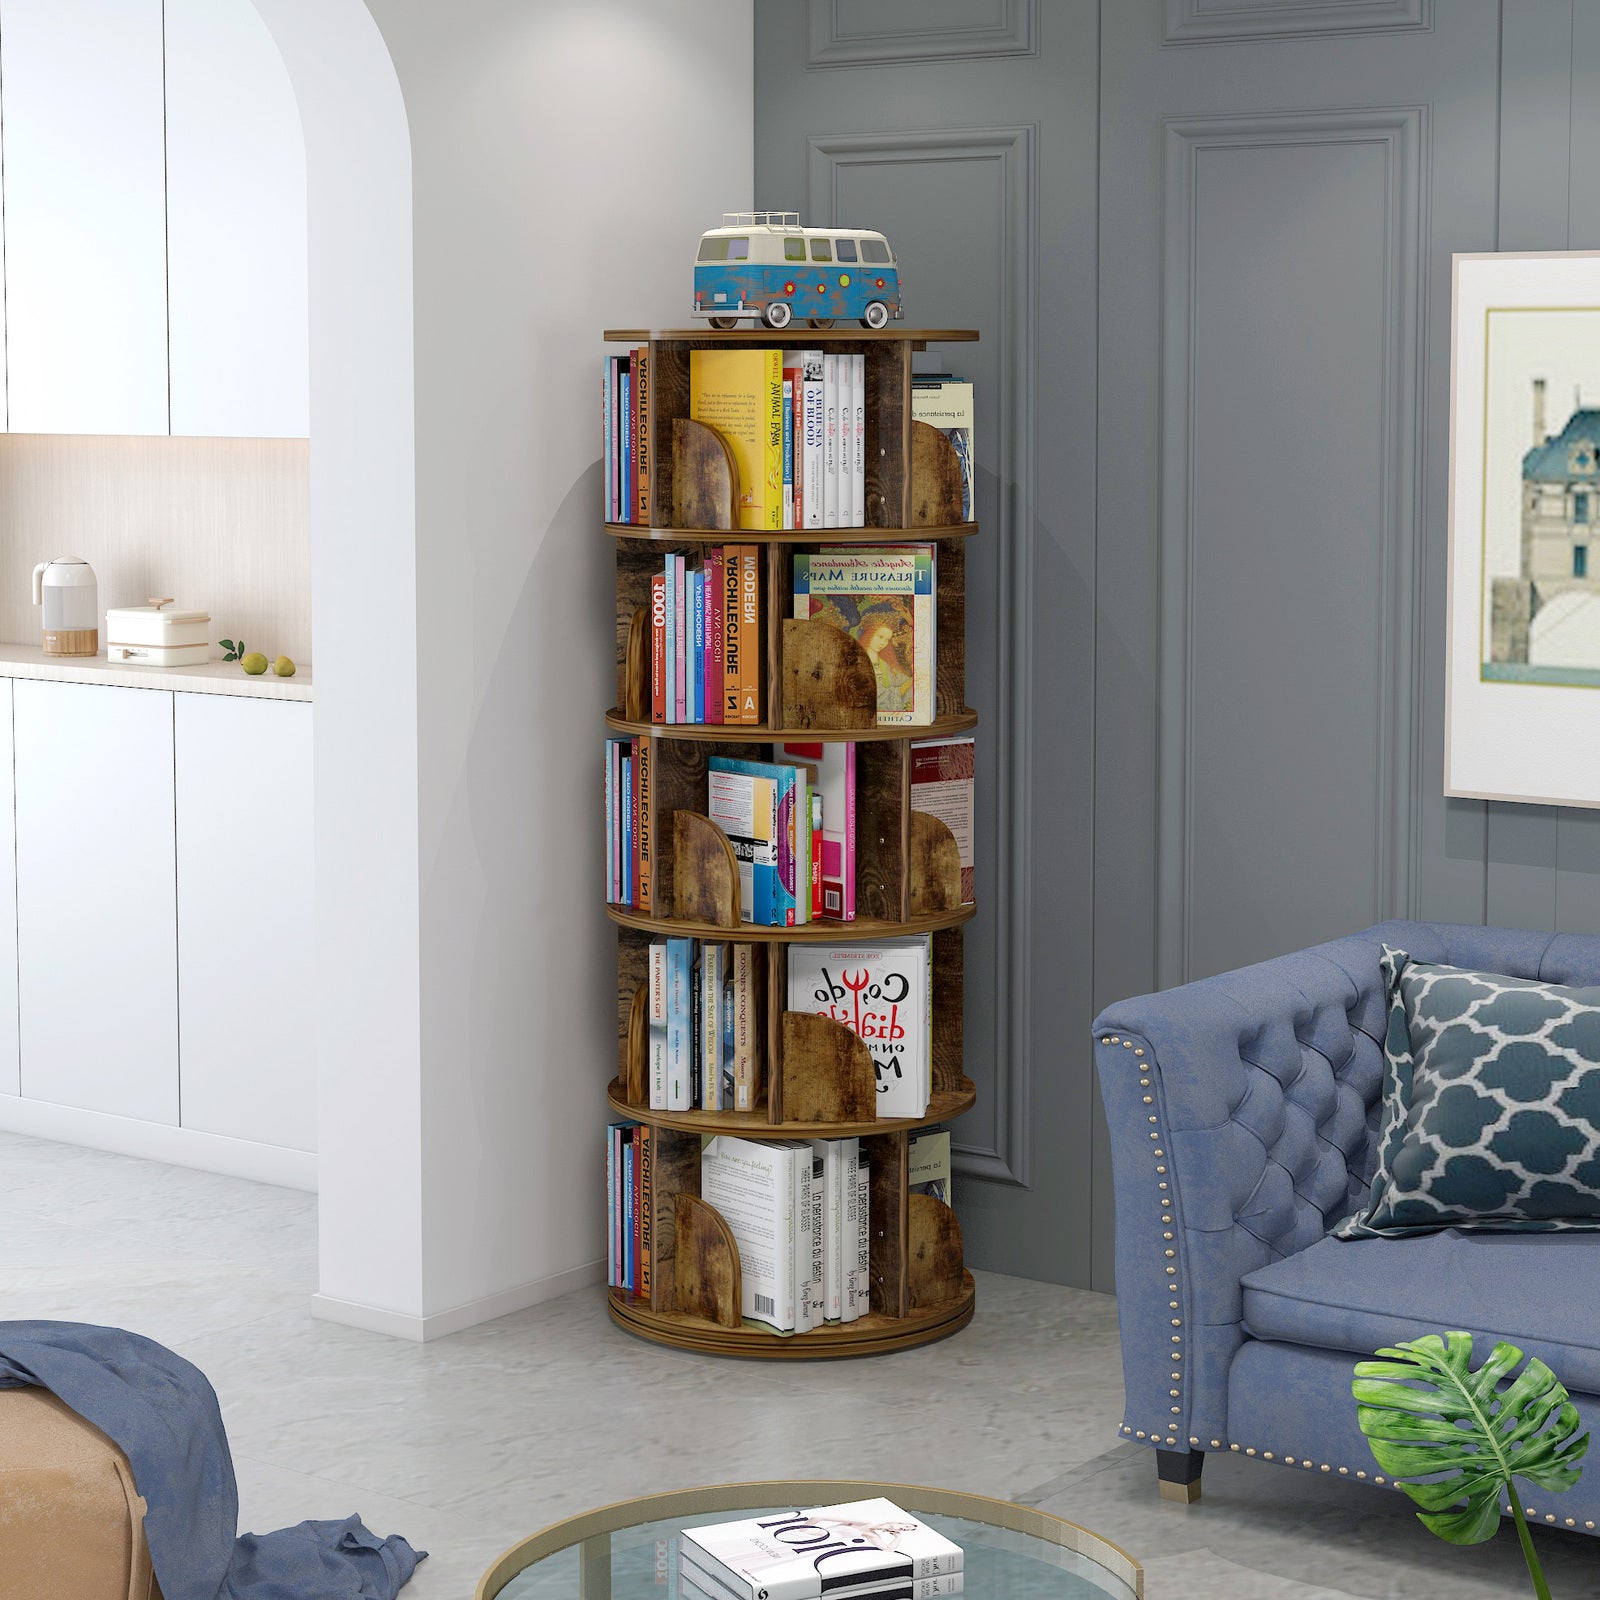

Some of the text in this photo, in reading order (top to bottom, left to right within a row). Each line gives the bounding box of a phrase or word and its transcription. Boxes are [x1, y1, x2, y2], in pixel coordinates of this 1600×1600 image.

[771, 382, 780, 419] ANIMAL
[807, 390, 814, 405] OF
[771, 422, 781, 446] FARM
[802, 1166, 810, 1183] THREE
[801, 1185, 810, 1198] PAIRS
[858, 1182, 869, 1191] La
[812, 1192, 824, 1201] La
[800, 1209, 810, 1232] GLASSES
[858, 1238, 869, 1249] du
[812, 1249, 824, 1259] du
[858, 1251, 869, 1273] destin
[812, 1262, 824, 1284] destin
